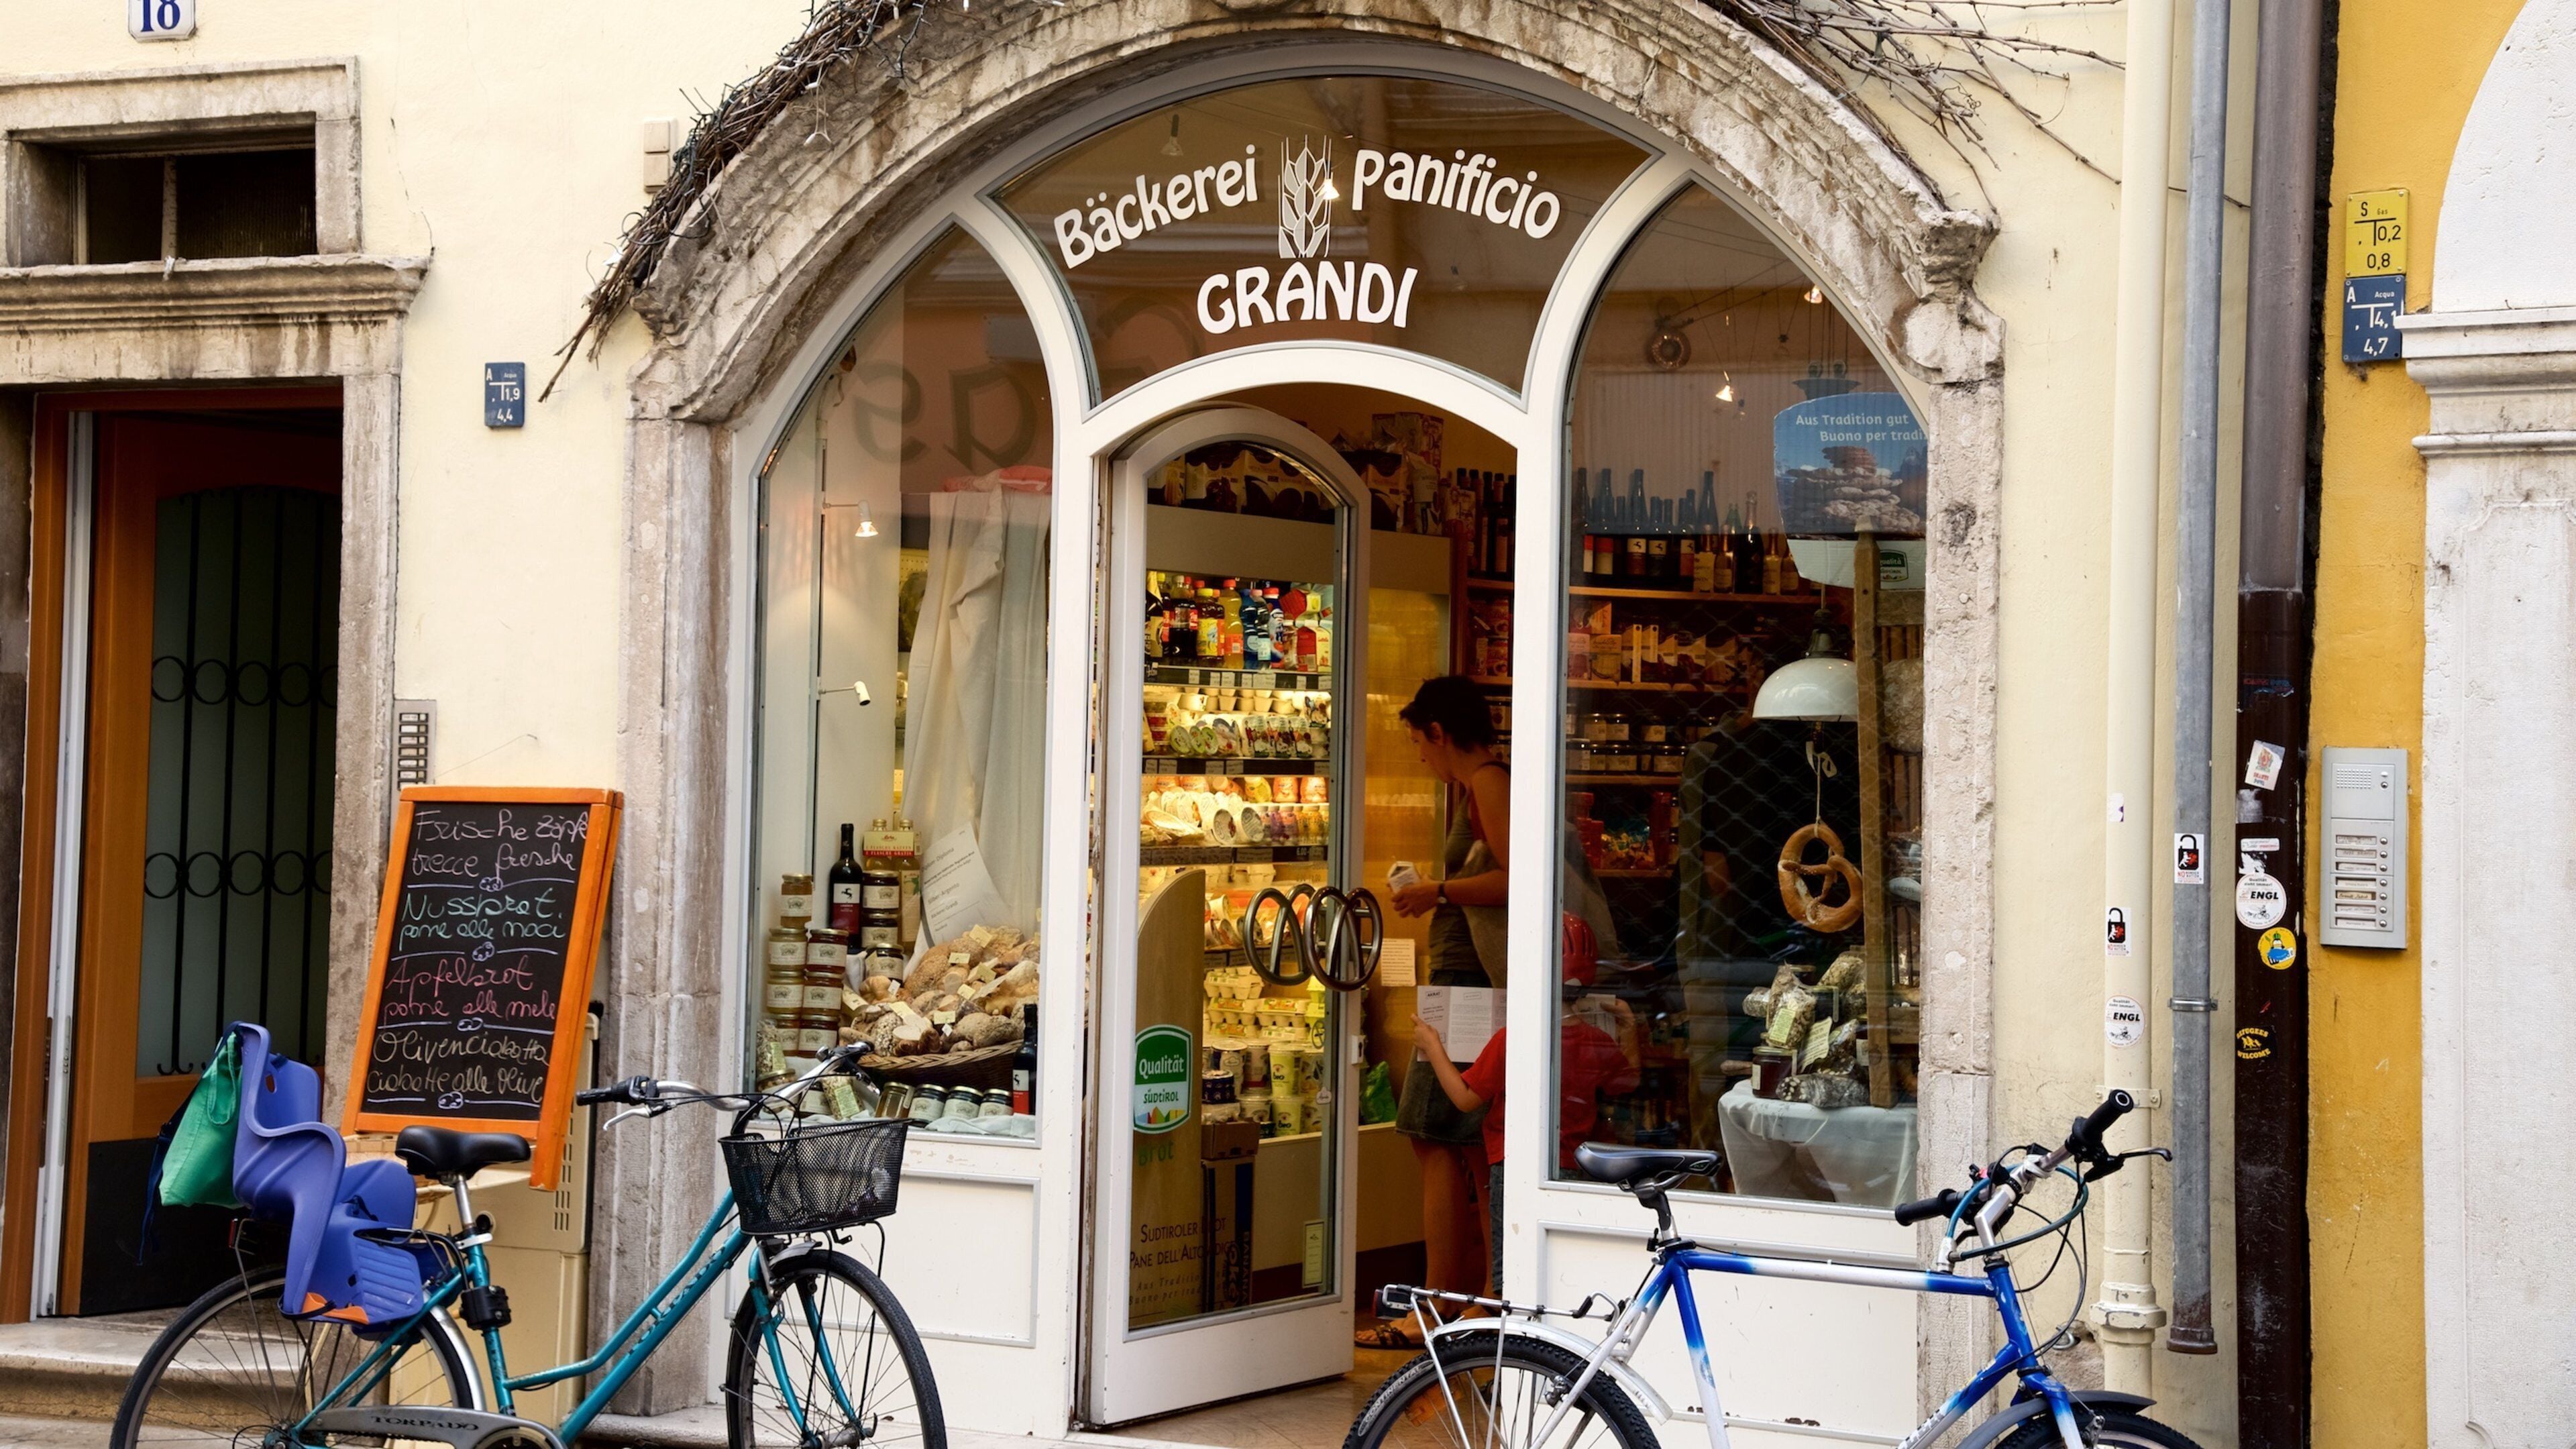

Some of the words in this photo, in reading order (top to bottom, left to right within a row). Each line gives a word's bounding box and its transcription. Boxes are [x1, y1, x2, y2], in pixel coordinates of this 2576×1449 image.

[140, 0, 180, 32] 18
[1053, 144, 1259, 270] Bäckerei
[2360, 201, 2368, 217] S
[2377, 225, 2402, 243] 0,2
[2367, 253, 2391, 270] 0,8
[1197, 260, 1417, 334] GRANDI
[2347, 286, 2356, 303] A
[2374, 291, 2395, 299] Acqua
[2363, 337, 2388, 356] 4,7
[486, 368, 492, 381] A
[497, 408, 513, 423] 4,4
[1796, 415, 1819, 425] Aus
[1822, 413, 1882, 425] Tradition
[1886, 413, 1909, 427] gut
[1820, 430, 1862, 442] Buono
[1866, 432, 1887, 443] per
[411, 848, 479, 877] trecce
[2250, 891, 2279, 900] ENGL
[398, 922, 452, 951] pane
[457, 918, 494, 939] alle
[503, 921, 566, 938] noci
[386, 955, 534, 1004] Apfelbrot
[384, 1000, 450, 1026] pane
[462, 989, 502, 1018] alle
[505, 989, 555, 1020] mele
[2113, 1012, 2141, 1022] ENGL
[1138, 1054, 1185, 1079] Qualität
[370, 1416, 480, 1430] TORPADO
